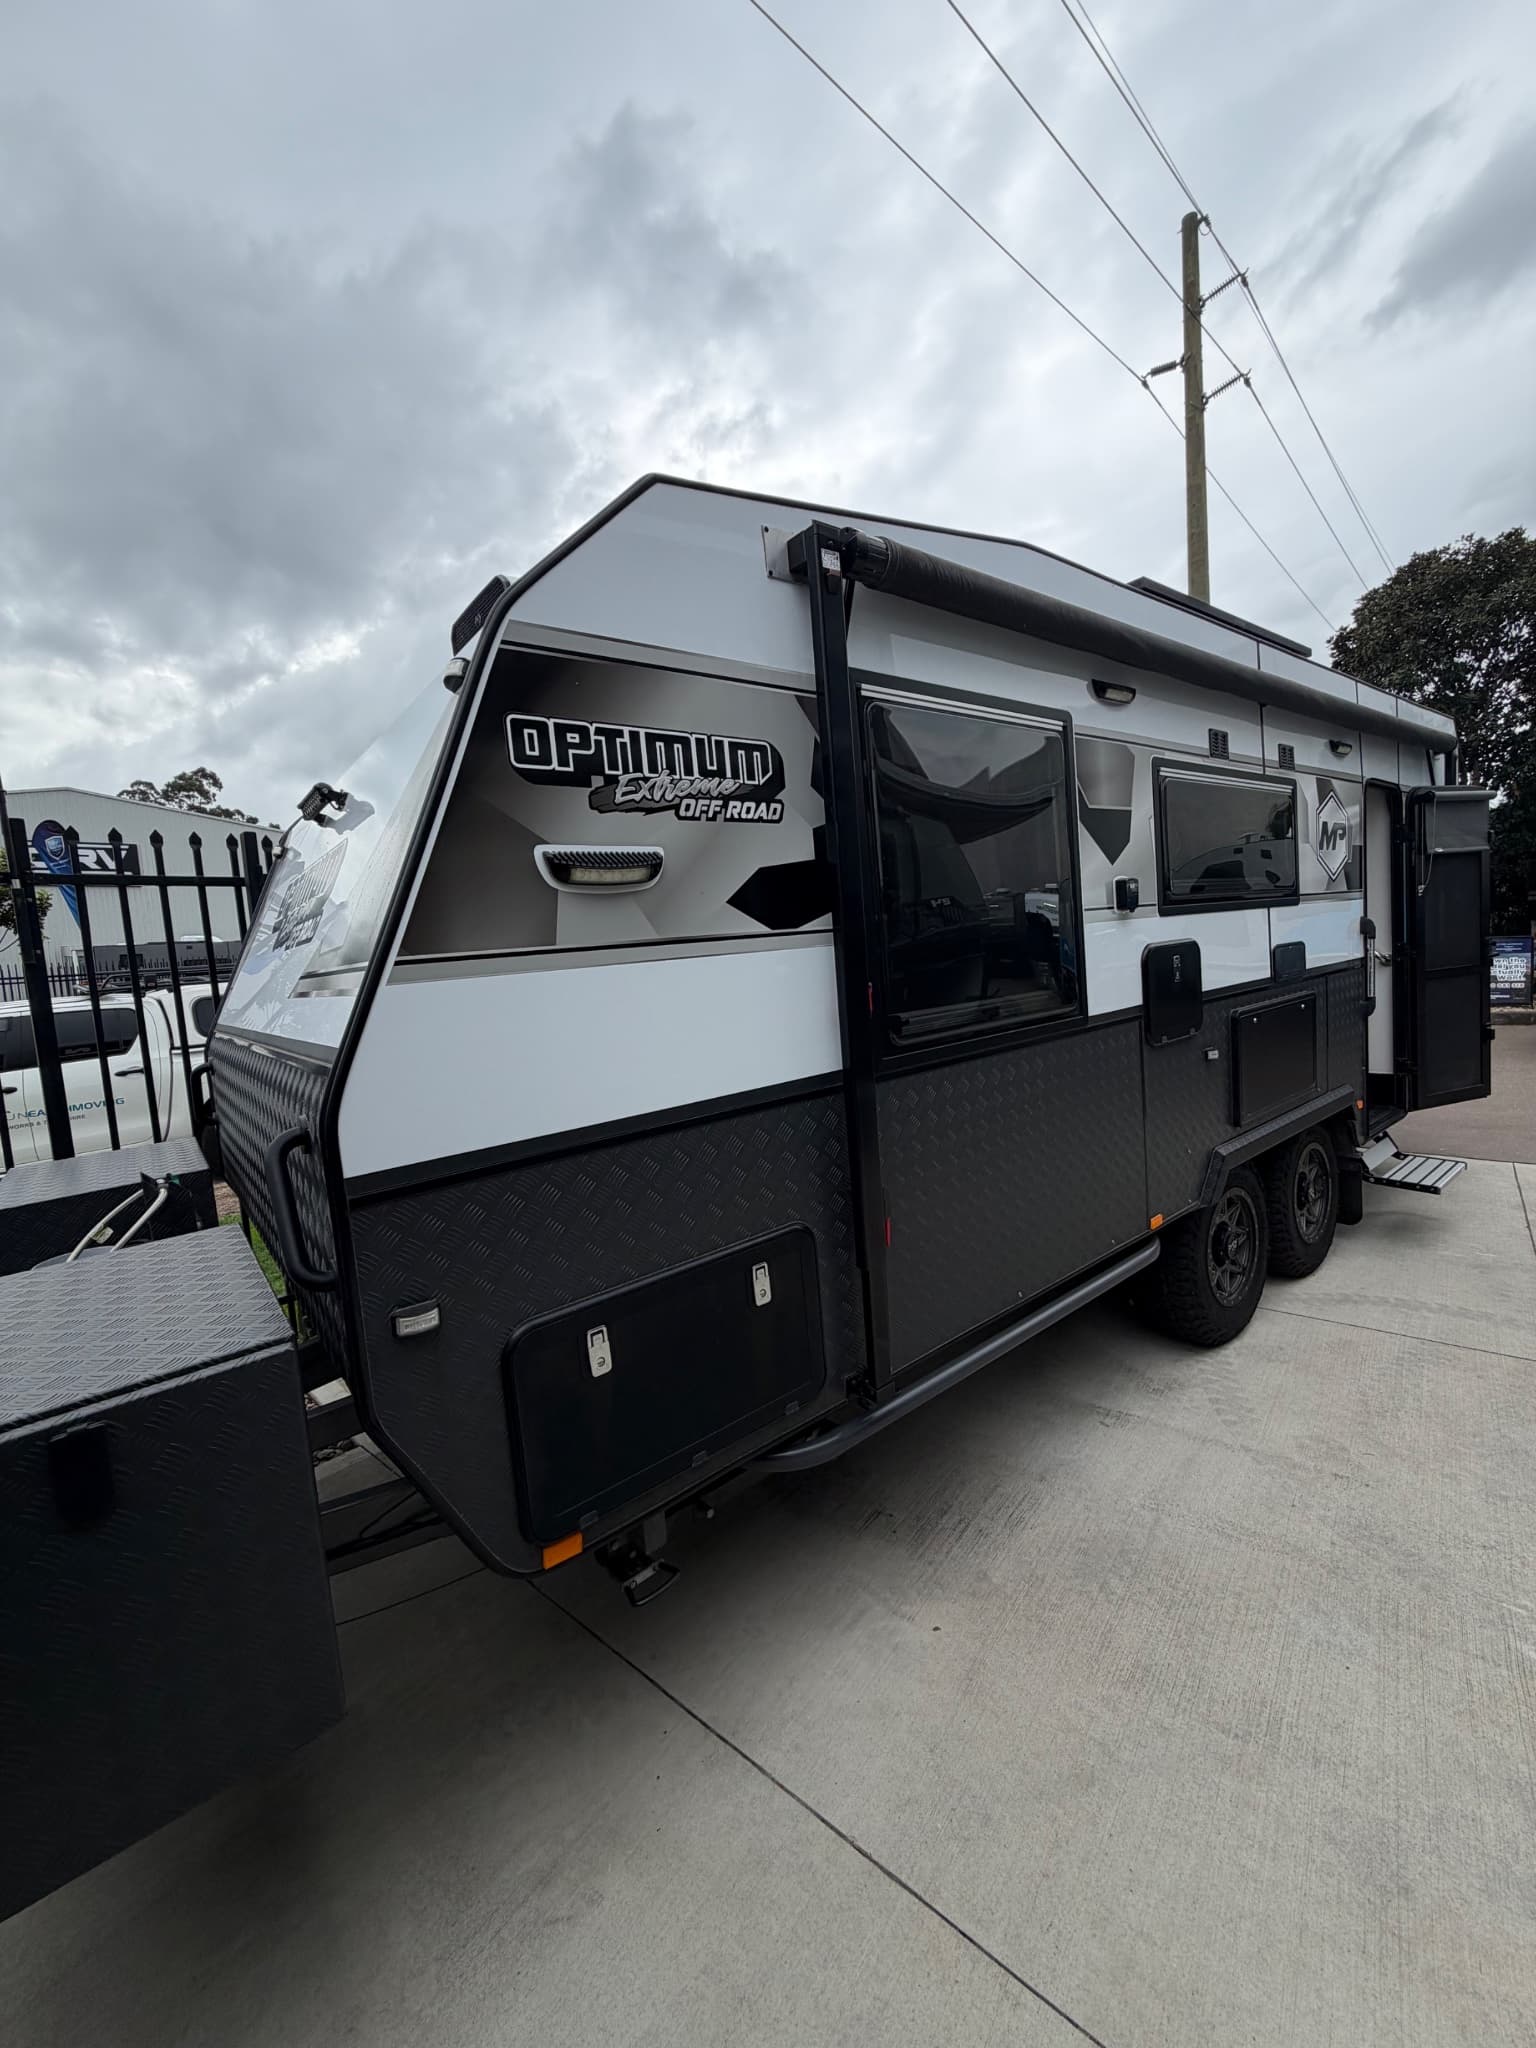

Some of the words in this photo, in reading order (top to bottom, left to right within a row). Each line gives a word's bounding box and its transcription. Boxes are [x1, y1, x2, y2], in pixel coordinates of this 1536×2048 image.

[505, 713, 774, 786] OPTIMUM
[613, 769, 742, 804] Extreme
[678, 799, 724, 819] OFF
[725, 801, 783, 821] ROAD
